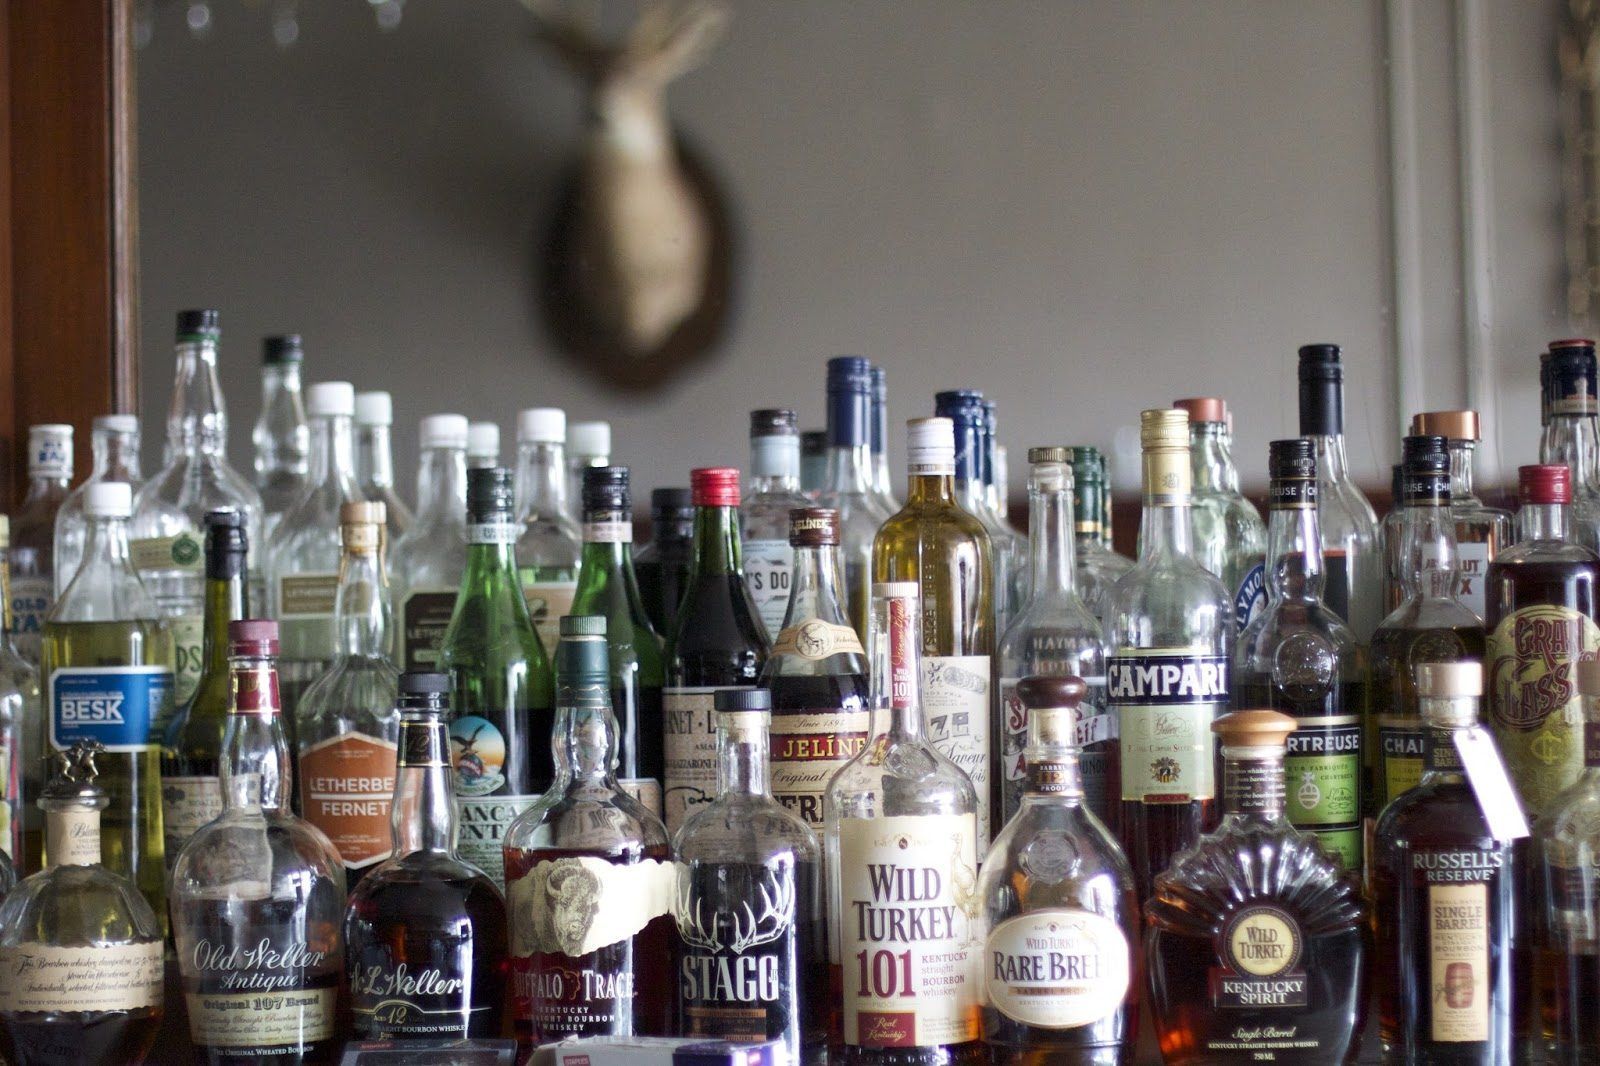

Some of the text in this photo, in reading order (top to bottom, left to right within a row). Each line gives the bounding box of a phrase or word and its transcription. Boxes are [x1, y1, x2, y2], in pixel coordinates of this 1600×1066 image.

[1108, 663, 1226, 698] CAMPARI
[894, 682, 912, 697] 101
[61, 700, 124, 720] BESK
[321, 801, 390, 817] FERNET
[1413, 851, 1504, 869] RUSSELL'S
[868, 863, 942, 903] WILD
[1426, 869, 1488, 882] RESERVE
[1435, 905, 1483, 919] SINGLE
[853, 901, 956, 943] TURKEY
[1435, 918, 1483, 931] BARREL
[1246, 926, 1278, 942] WILD
[1025, 937, 1048, 950] WILD
[1238, 941, 1285, 960] TURKEY
[193, 938, 241, 971] Old
[243, 937, 325, 970] Weller
[921, 951, 968, 964] KENTUCKY
[856, 949, 916, 998] 101
[993, 950, 1106, 983] RARE BREE
[219, 970, 299, 993] Antique
[512, 969, 635, 1001] BUFFALO TRACE
[682, 955, 780, 1002] STAGG
[922, 974, 965, 986] BOURBON
[1223, 980, 1304, 994] KENTUCKY
[253, 996, 284, 1011] 107
[1239, 992, 1288, 1005] SPIRIT
[387, 1006, 408, 1025] 12
[567, 1014, 616, 1023] BOURBON
[1232, 1025, 1298, 1042] Single Barrel
[255, 1047, 288, 1056] WHEATED
[1208, 1042, 1239, 1050] KENTUCKY
[1267, 1041, 1295, 1049] BOURBON
